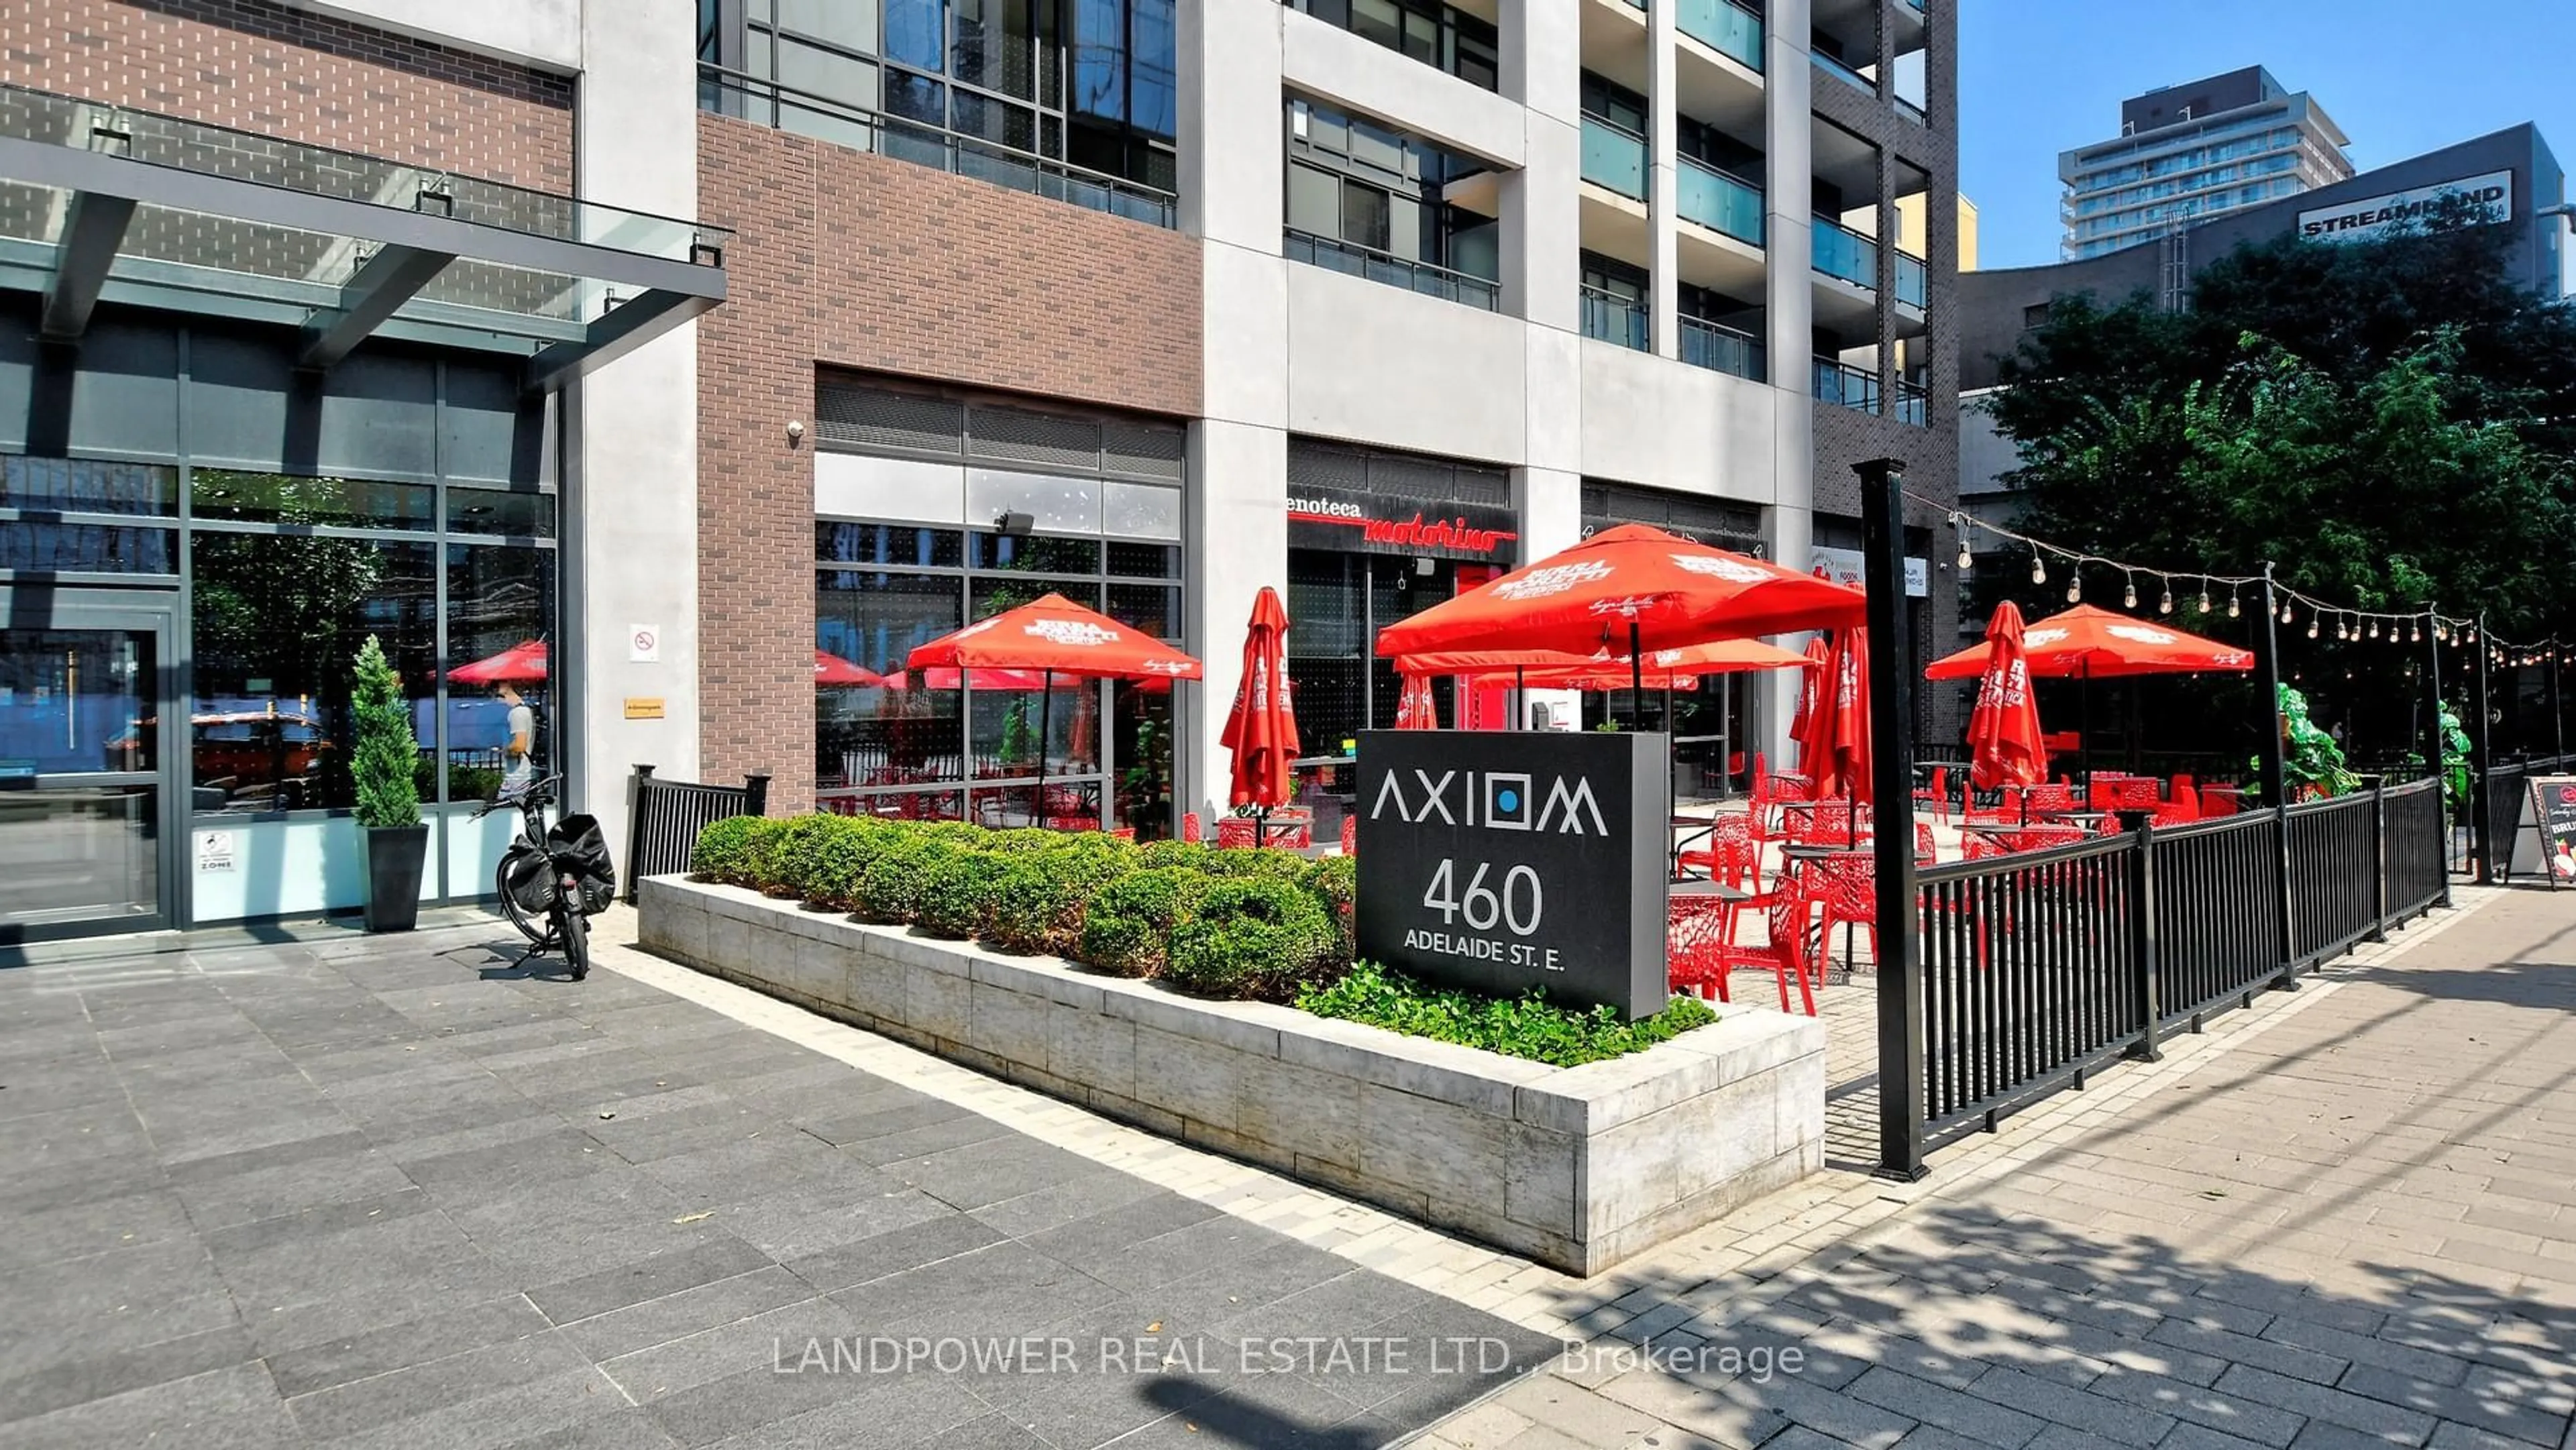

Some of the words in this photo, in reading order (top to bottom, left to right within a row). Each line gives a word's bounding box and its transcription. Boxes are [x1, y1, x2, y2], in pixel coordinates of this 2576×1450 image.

[2304, 186, 2505, 236] STREAMND
[1286, 496, 1362, 518] enoteca
[1364, 512, 1500, 552] motorino
[1371, 768, 1609, 837] AXIOM
[2551, 822, 2576, 834] BRU
[1423, 858, 1544, 936] 460
[1405, 929, 1504, 962] ADELAIDE
[1509, 944, 1538, 967] ST.
[1545, 949, 1566, 972] E.
